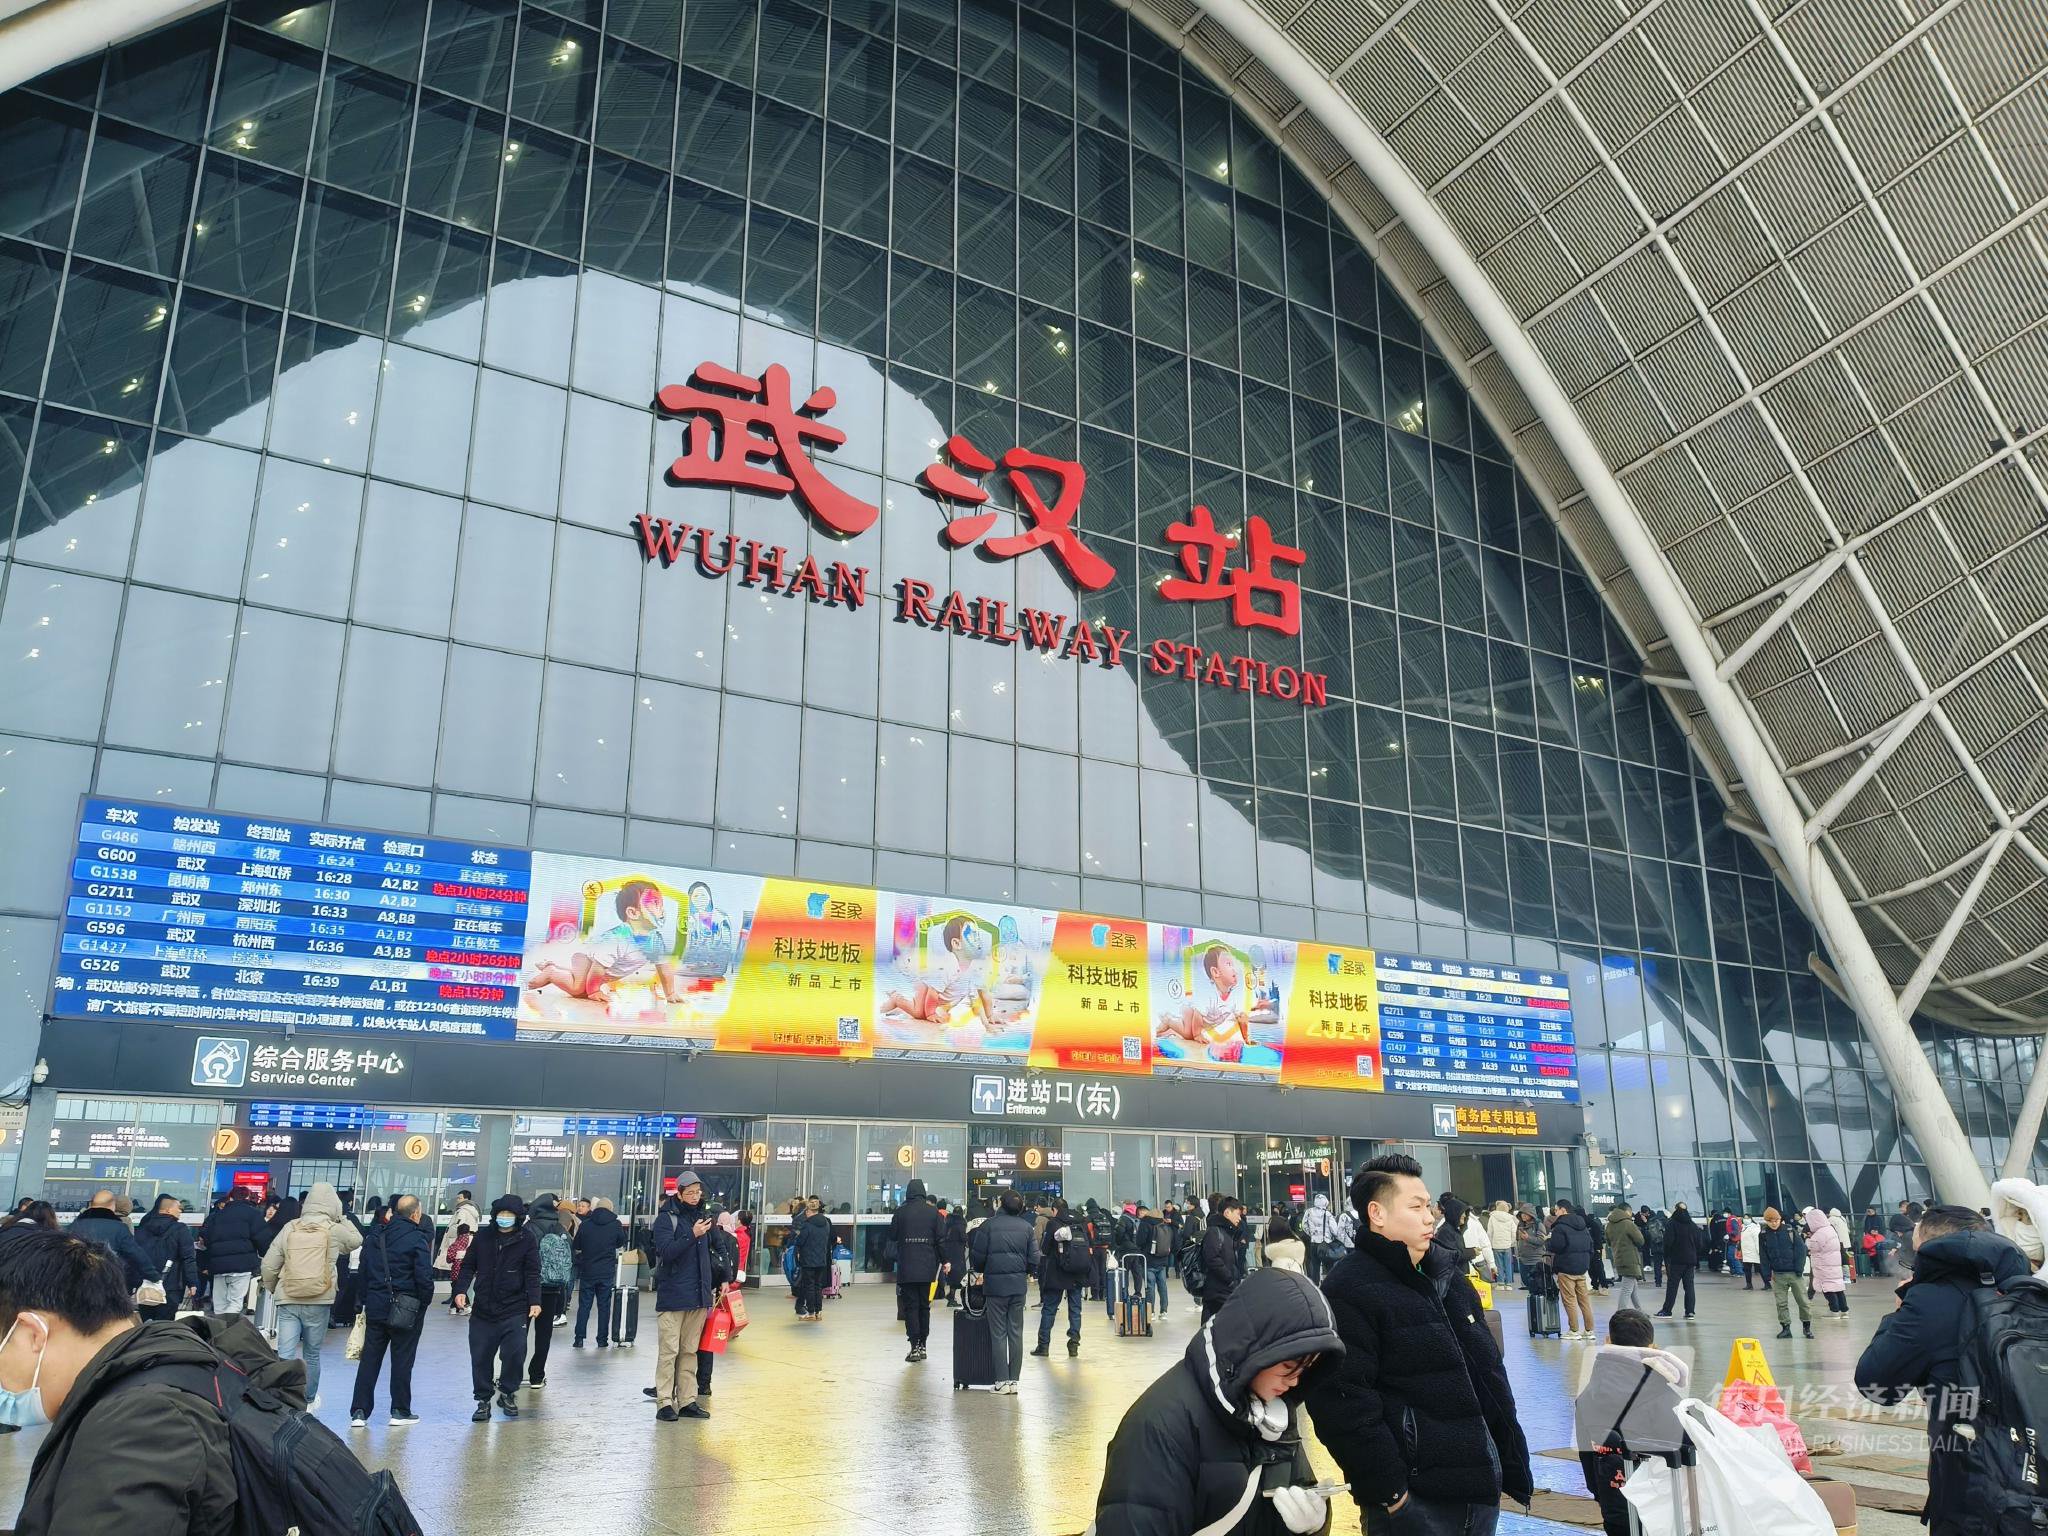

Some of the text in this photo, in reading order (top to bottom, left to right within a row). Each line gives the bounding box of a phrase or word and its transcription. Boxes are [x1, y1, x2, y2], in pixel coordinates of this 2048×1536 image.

[657, 361, 1306, 635] 武汉站
[635, 513, 1328, 707] WUHAN RAILWAY STATION
[101, 829, 139, 844] G486
[106, 808, 139, 824] 车次
[173, 816, 220, 835] 始发站
[246, 824, 292, 843] 终到站
[309, 831, 366, 851] 实际开点
[382, 839, 425, 858] 检票口
[97, 847, 136, 863] G600
[176, 856, 206, 871] 武汉
[235, 863, 292, 881] 上海虹桥
[316, 870, 352, 884] 16:28
[381, 877, 419, 892] A2,B2
[90, 865, 137, 881] G1538
[167, 872, 210, 890] 昆明南
[240, 880, 282, 897] 郑州东
[314, 887, 350, 901] 16:30
[87, 883, 134, 899] G2711
[171, 891, 201, 907] 武汉
[238, 897, 281, 914] 深圳北
[312, 904, 348, 919] 16:33
[830, 900, 863, 920] 圣象
[85, 902, 132, 918] G1152
[309, 922, 345, 936] 16:35
[86, 921, 125, 935] G596
[166, 928, 196, 943] 武汉
[232, 932, 276, 950] 杭州西
[307, 939, 344, 954] 16:36
[373, 945, 412, 960] A3,B3
[774, 937, 862, 964] 科技地板
[1111, 931, 1137, 950] 圣象
[80, 958, 120, 972] G526
[160, 964, 191, 979] 武汉
[235, 969, 265, 985] 北京
[302, 974, 340, 988] 16:39
[369, 979, 408, 994] A1,B1
[788, 972, 862, 991] 新品上市
[1067, 964, 1138, 990] 科技地板
[1080, 997, 1140, 1014] 新品上市
[1309, 989, 1369, 1013] 科技地板
[1321, 1020, 1371, 1035] 新品上市
[251, 1044, 405, 1075] 综合服务中心
[250, 1070, 357, 1087] Service Center
[1006, 1077, 1121, 1120] 进站口(东)
[1006, 1102, 1046, 1115] Entrance
[1455, 1107, 1537, 1127] 商务座专用通道
[221, 1134, 231, 1150] 7
[411, 1139, 422, 1154] 6
[597, 1143, 607, 1160] 5
